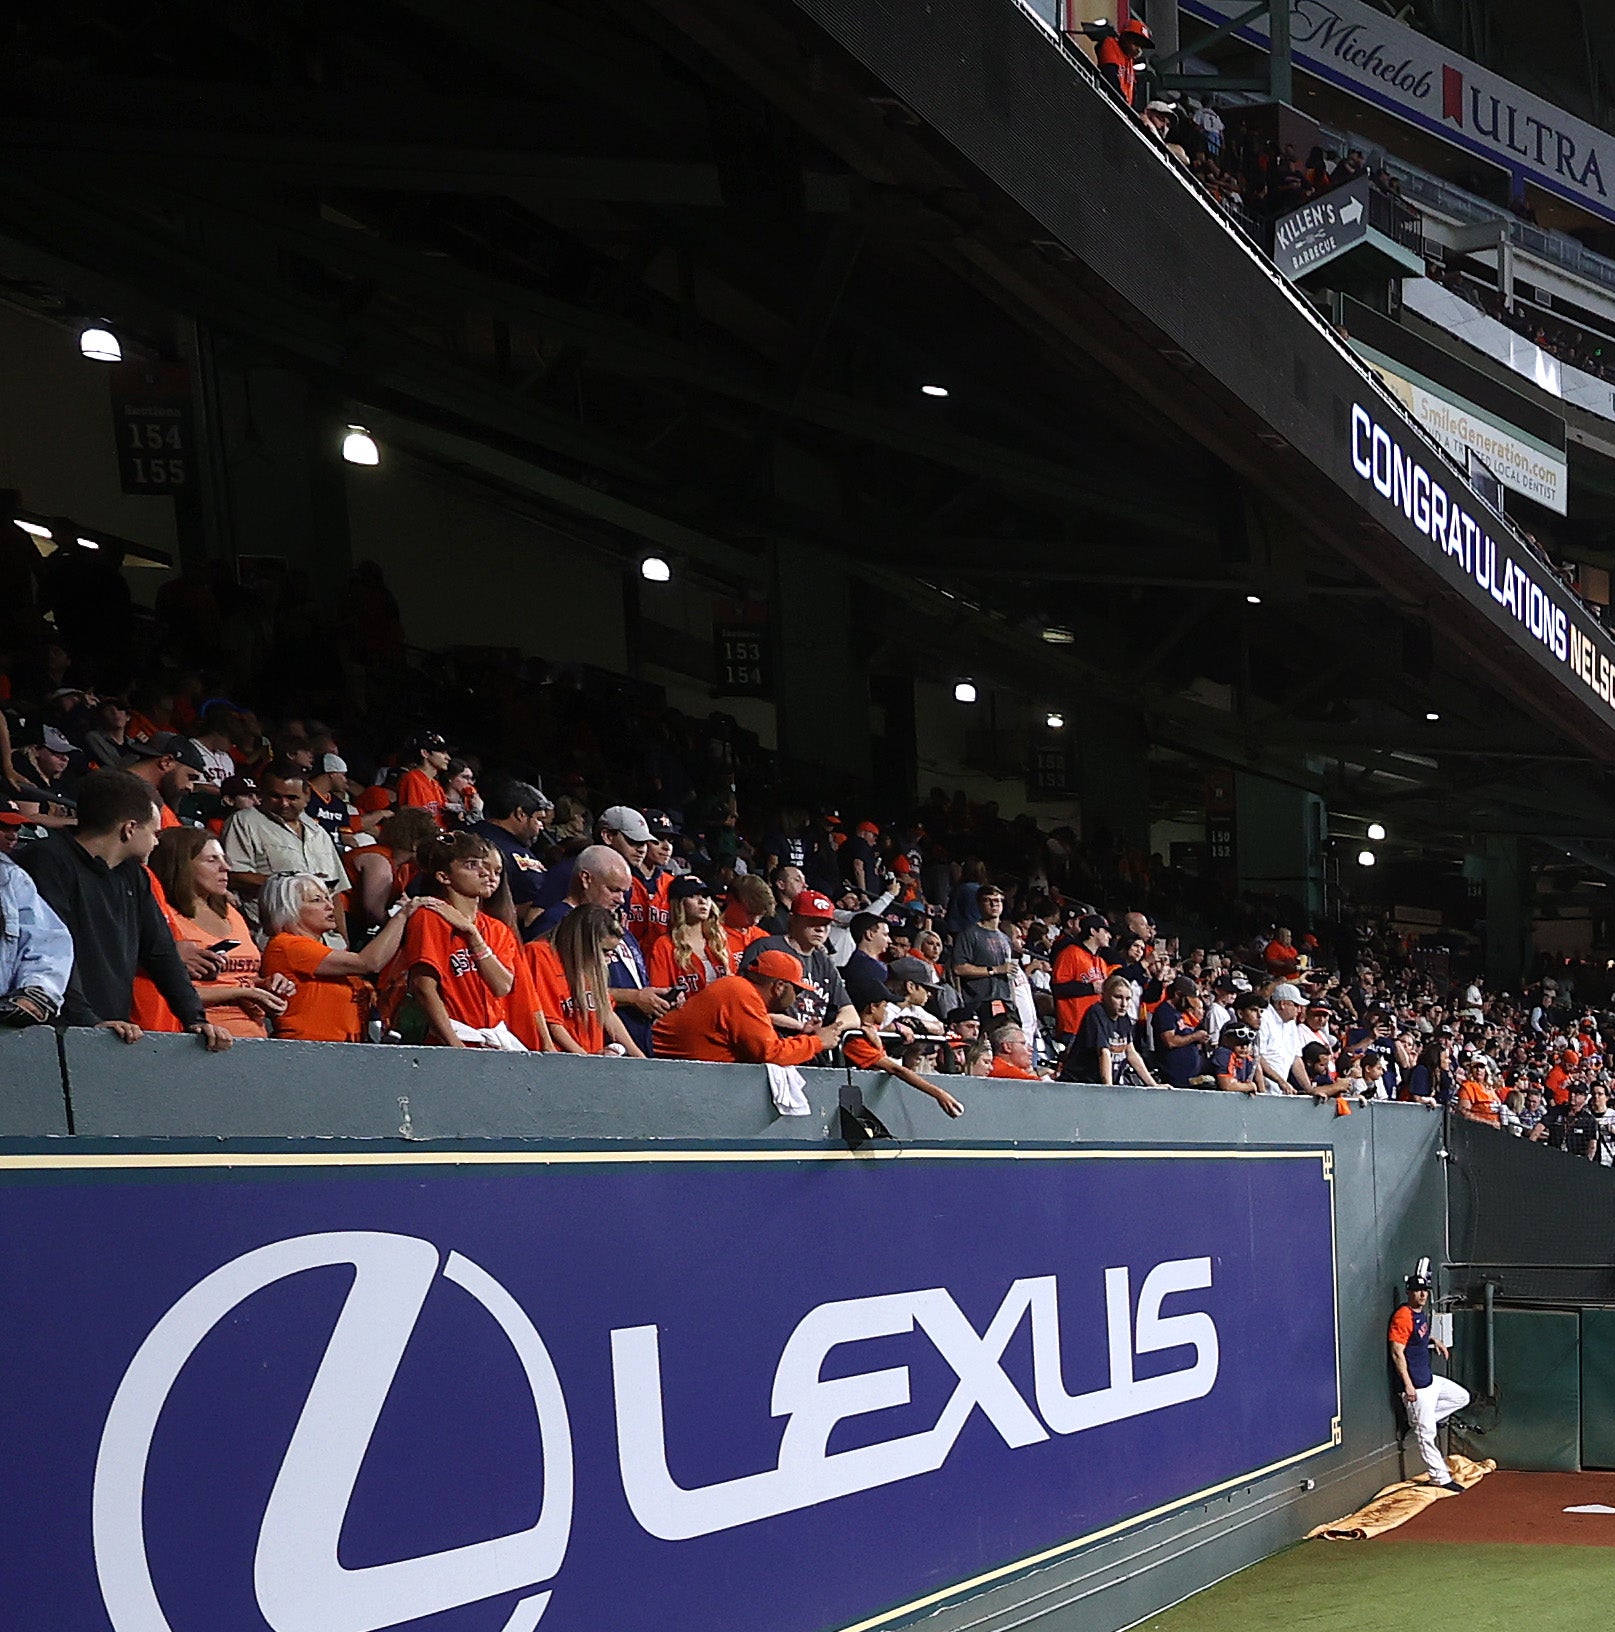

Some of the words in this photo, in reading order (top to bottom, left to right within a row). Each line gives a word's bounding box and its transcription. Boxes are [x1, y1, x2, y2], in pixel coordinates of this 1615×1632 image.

[1290, 0, 1432, 101] Michelob
[1471, 85, 1607, 197] ULTRA
[1277, 204, 1336, 250] KILLEN'S
[1292, 236, 1336, 270] BARBECUE
[128, 423, 184, 449] 154
[1420, 397, 1557, 486] SmileGeneration.com
[132, 458, 186, 484] 155
[1453, 440, 1492, 469] TRTED
[1494, 460, 1521, 485] LOCAL
[1522, 475, 1557, 502] DENTIST
[1351, 403, 1567, 662] CONGRATULATIONS
[608, 1256, 1220, 1542] LEXUS
